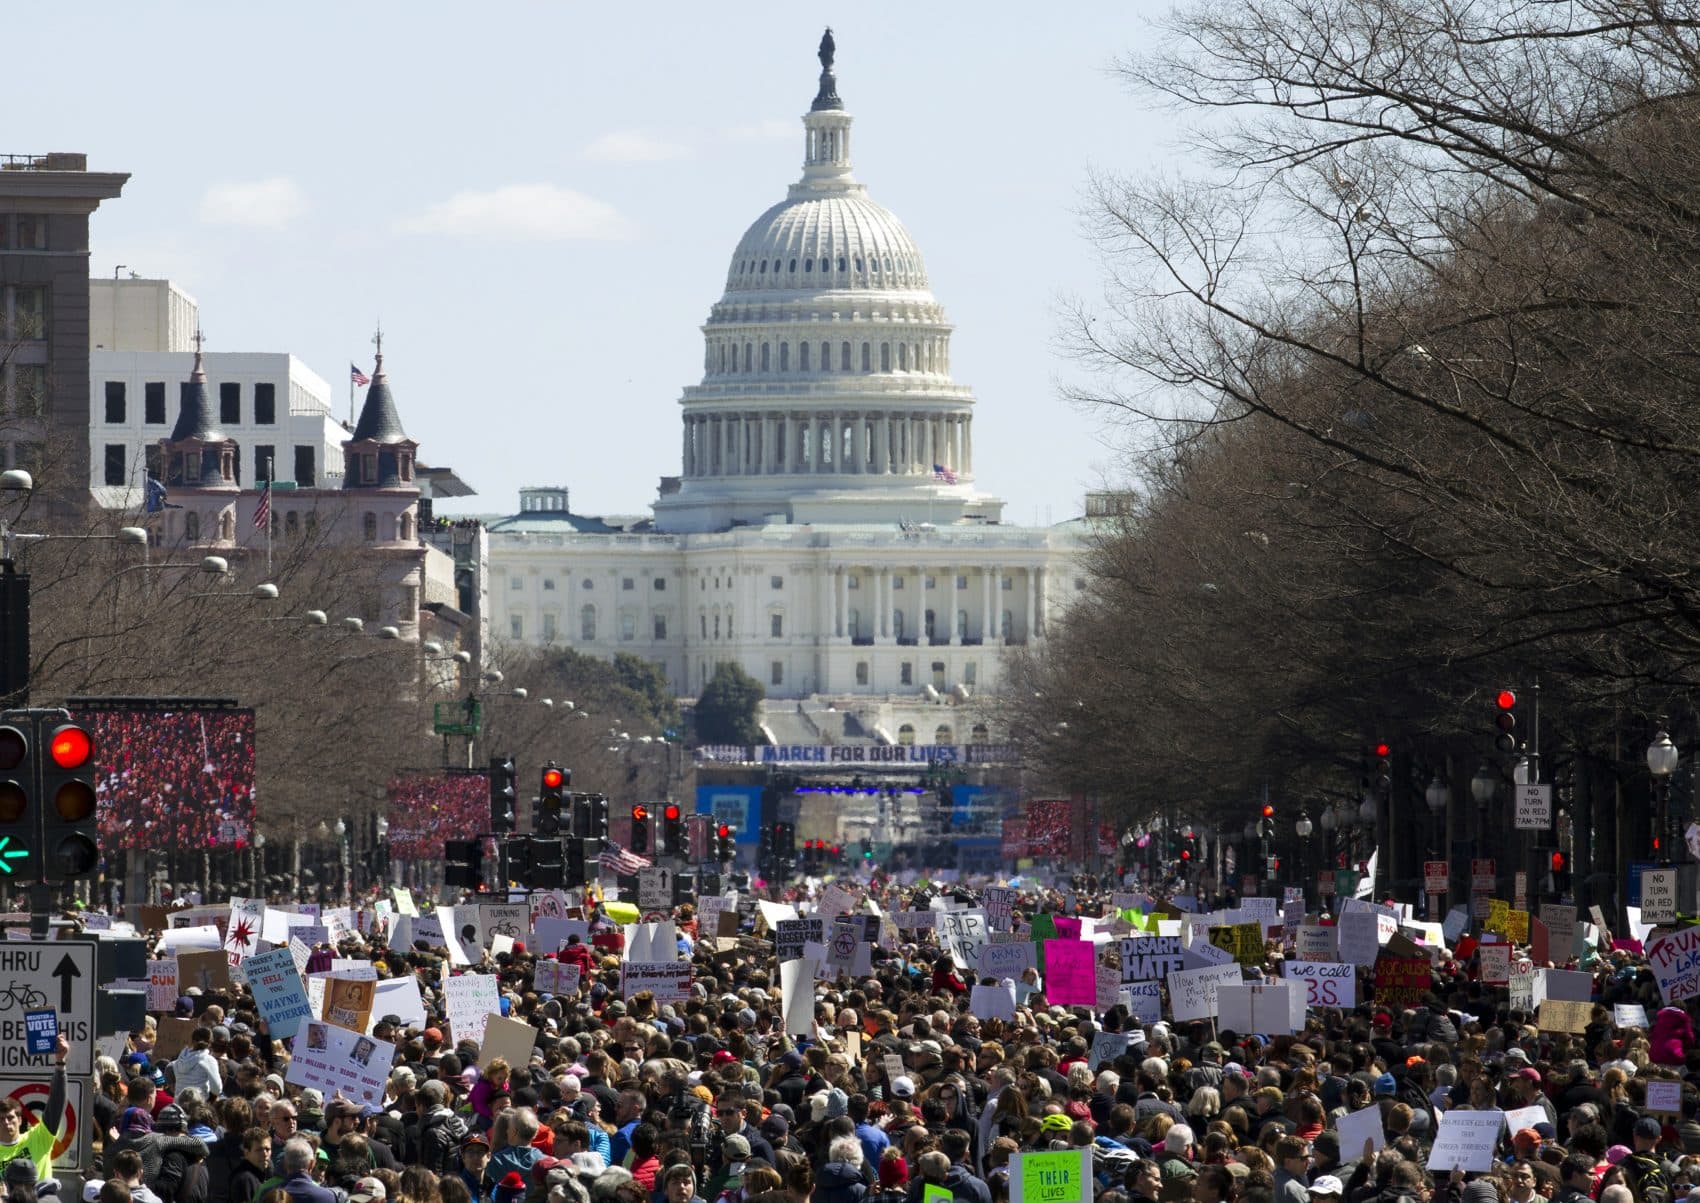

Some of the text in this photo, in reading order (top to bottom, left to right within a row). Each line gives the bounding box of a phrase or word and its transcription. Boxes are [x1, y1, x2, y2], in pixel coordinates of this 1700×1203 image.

[762, 746, 825, 761] MARCH
[830, 746, 866, 761] FOR
[870, 746, 905, 761] OUR
[910, 746, 958, 762] LIVES
[1528, 788, 1539, 796] NO
[1524, 798, 1543, 806] TURN
[1652, 874, 1664, 883] NO
[1649, 886, 1668, 896] TURN
[1644, 898, 1672, 907] ON RED
[490, 908, 520, 918] TURNING
[1642, 910, 1674, 919] 7AM-7PM
[810, 919, 822, 930] NO
[1122, 937, 1183, 955] DISARM
[1649, 932, 1700, 968] TRUM
[248, 955, 272, 967] THERE'S
[991, 950, 1021, 960] ARMS
[1122, 955, 1184, 980] HATE
[1291, 965, 1351, 978] we call
[1510, 961, 1533, 976] STOP
[152, 975, 176, 986] GUN
[262, 974, 284, 985] HELL
[1173, 974, 1194, 990] How
[1670, 975, 1698, 1000] EASY
[262, 993, 301, 1011] WAYNE
[1511, 995, 1533, 1009] FEAR
[268, 1004, 312, 1024] APIERRE
[27, 1019, 56, 1031] VOTE
[58, 1022, 88, 1042] HIS
[1, 1046, 56, 1067] IGNAL
[361, 1076, 381, 1087] MONEY
[1040, 1170, 1069, 1185] THEIR
[1041, 1187, 1065, 1198] LIVES
